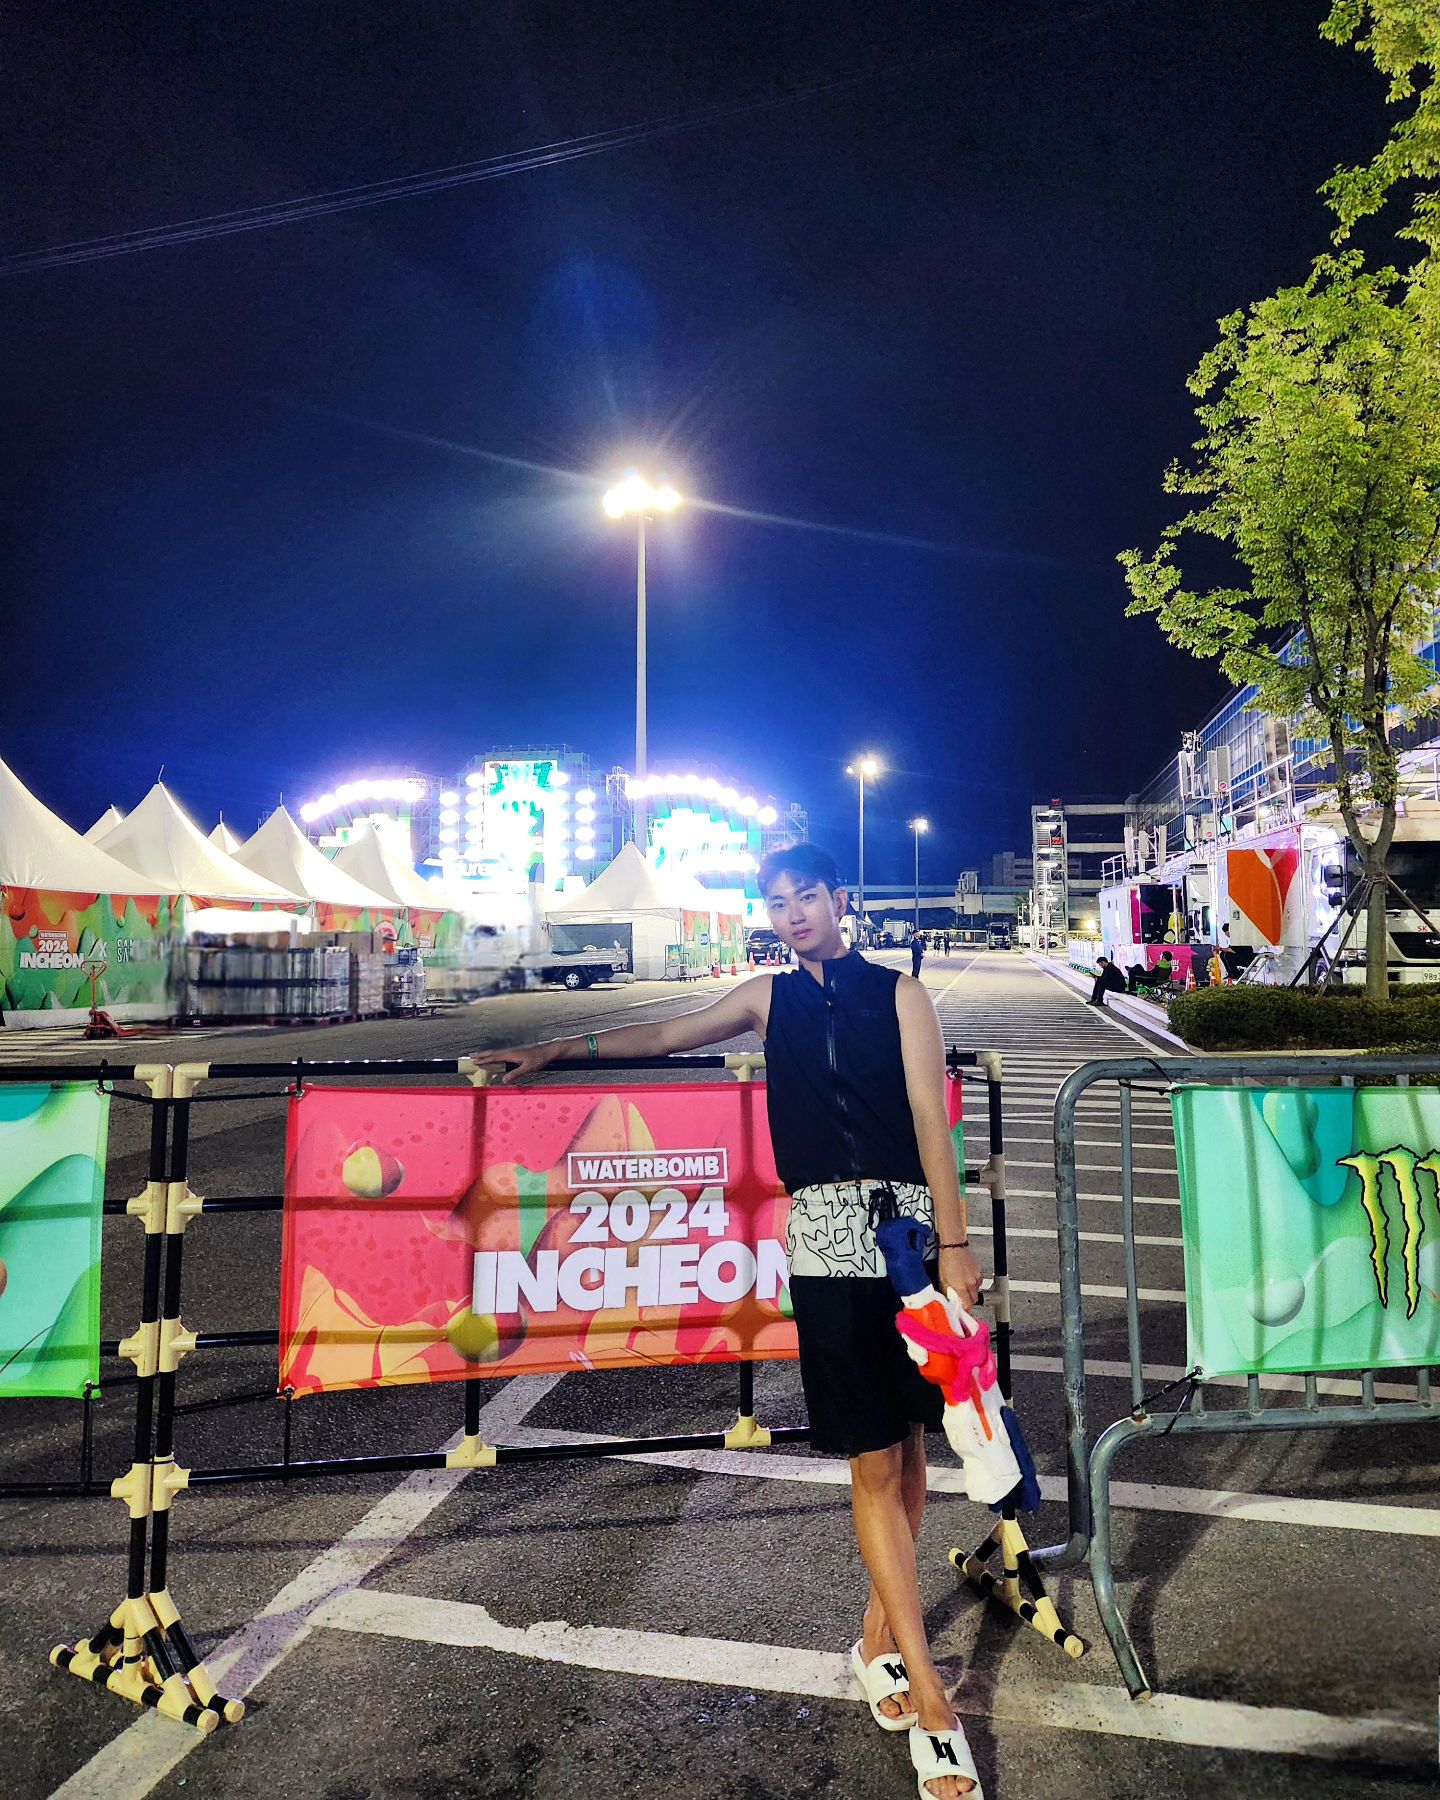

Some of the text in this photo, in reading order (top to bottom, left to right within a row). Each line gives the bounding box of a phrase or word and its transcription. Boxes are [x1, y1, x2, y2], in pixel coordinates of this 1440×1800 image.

[38, 940, 68, 952] 2024
[20, 952, 86, 969] INCHEON
[577, 1155, 720, 1180] WATERBOMB
[568, 1186, 730, 1243] 2024
